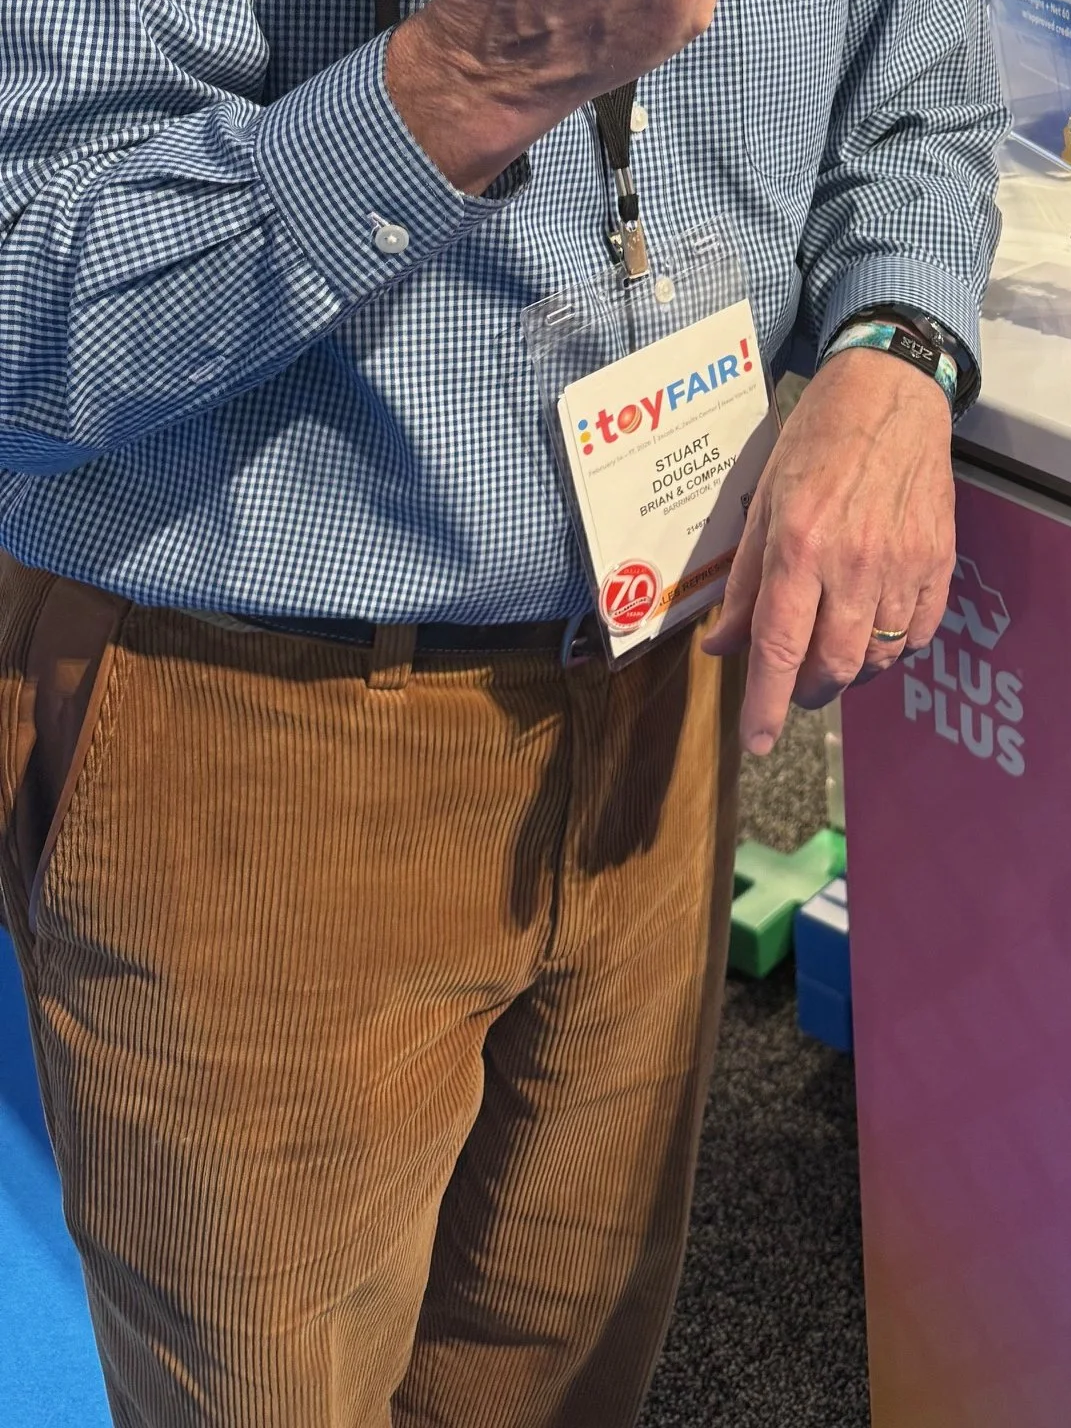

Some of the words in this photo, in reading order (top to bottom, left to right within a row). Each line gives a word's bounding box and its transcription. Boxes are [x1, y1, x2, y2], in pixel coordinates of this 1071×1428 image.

[652, 447, 721, 494] DOUGLAS
[655, 433, 710, 473] STUART
[639, 490, 674, 517] BRIAN
[676, 485, 684, 496] &
[686, 454, 738, 490] COMPANY
[610, 573, 655, 611] 70
[903, 672, 1027, 778] PLUS
